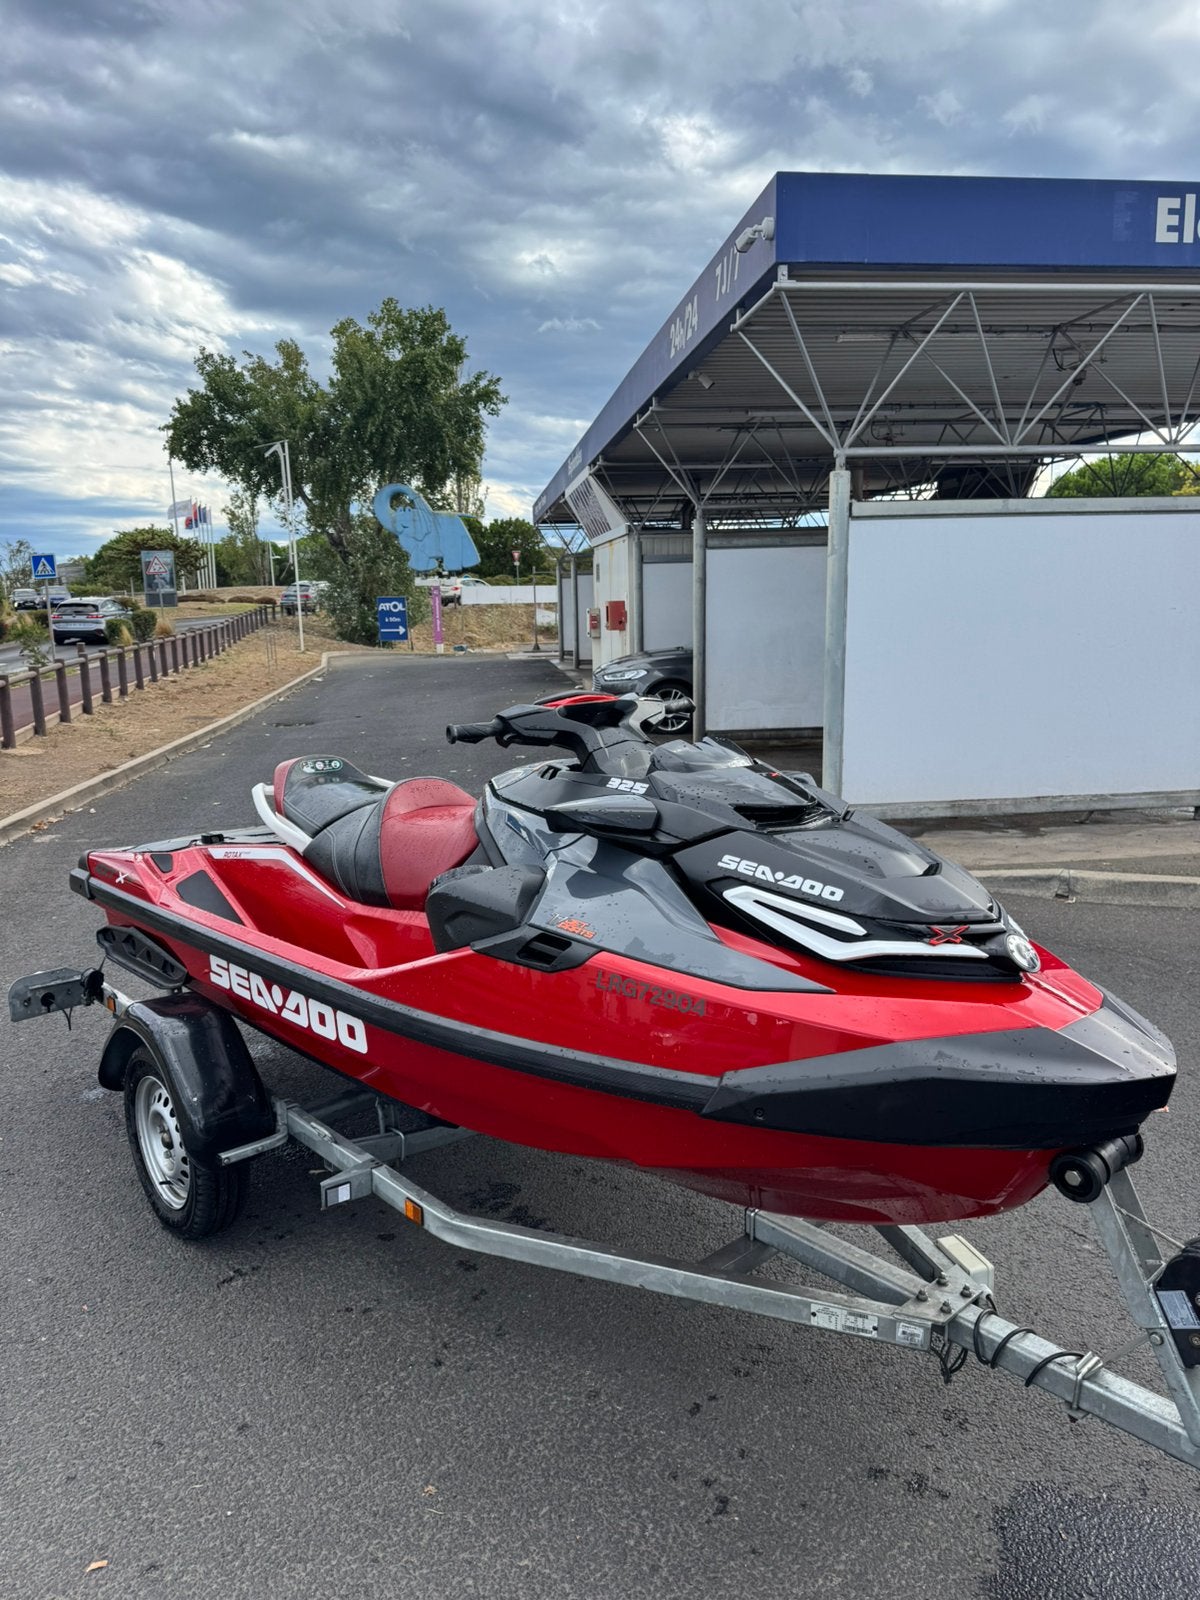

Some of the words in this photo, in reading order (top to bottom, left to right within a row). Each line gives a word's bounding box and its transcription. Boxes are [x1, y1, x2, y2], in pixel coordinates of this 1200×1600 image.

[1155, 193, 1200, 243] El
[378, 601, 406, 612] ATOL
[606, 777, 650, 795] 325
[596, 969, 707, 1018] LRG72904
